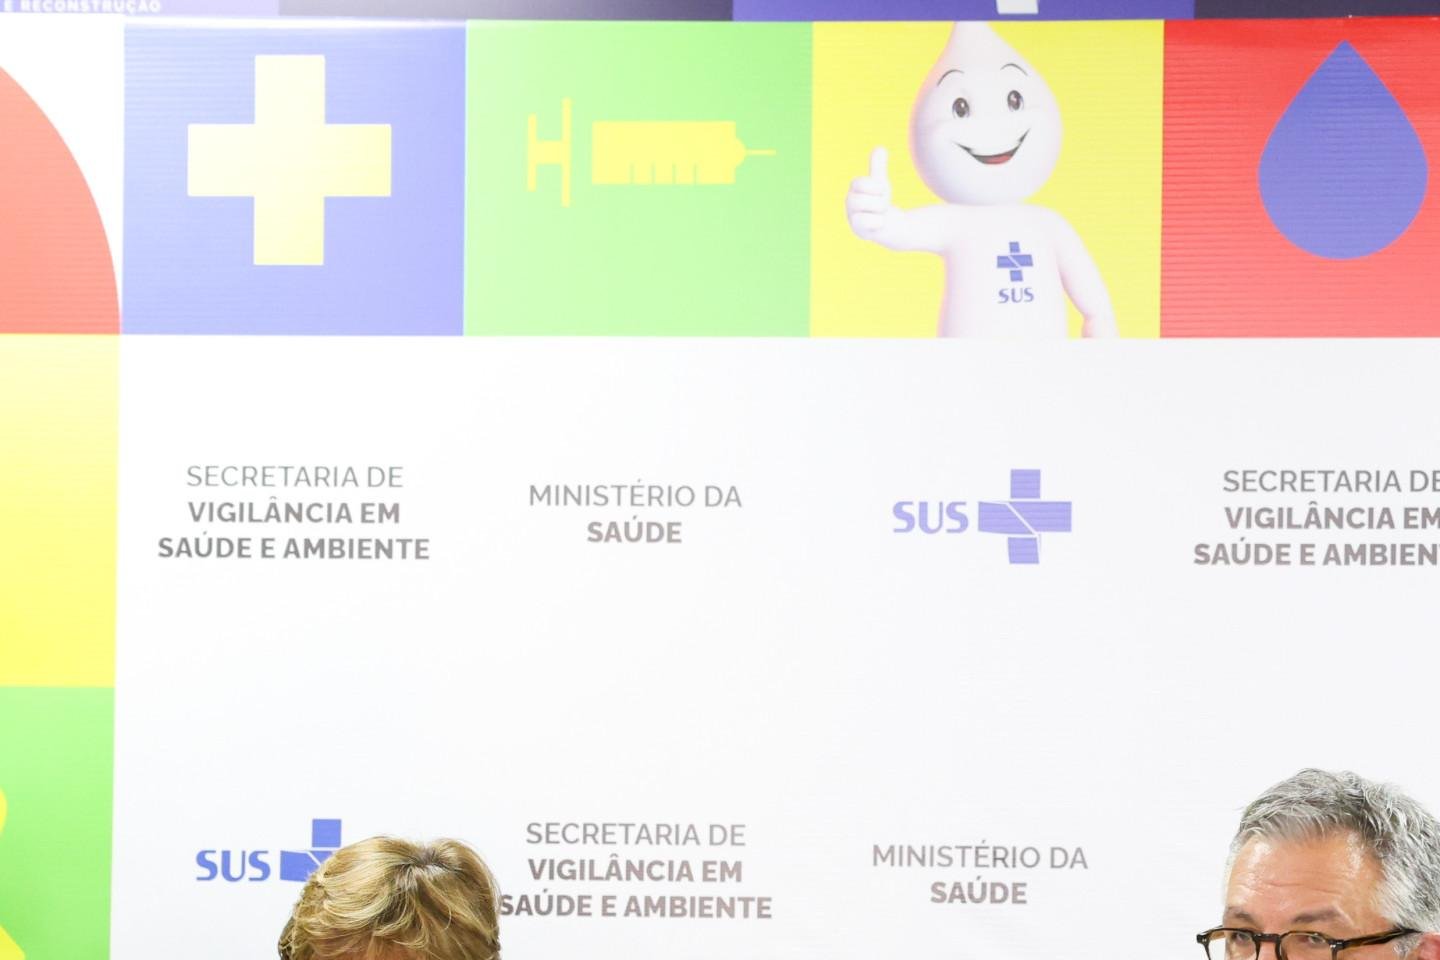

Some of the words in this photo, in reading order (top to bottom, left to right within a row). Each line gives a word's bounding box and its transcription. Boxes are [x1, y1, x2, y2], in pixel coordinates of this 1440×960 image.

[997, 287, 1035, 304] SUS
[186, 465, 360, 488] SECRETARIA
[367, 465, 403, 488] DE
[1222, 469, 1402, 493] SECRETARIA
[529, 478, 696, 508] MINISTÉRIO
[704, 485, 743, 508] DA
[187, 495, 353, 524] VIGILÂNCIA
[360, 502, 400, 524] EM
[892, 500, 970, 535] SUS
[1223, 500, 1396, 530] VIGILÂNCIA
[586, 514, 683, 544] SAÚDE
[157, 531, 252, 559] SAÚDE
[260, 537, 276, 559] E
[282, 537, 430, 560] AMBIENTE
[1193, 536, 1292, 566] SAÚDE
[1299, 543, 1316, 566] E
[525, 822, 701, 846] SECRETARIA
[708, 823, 746, 847] DE
[195, 849, 272, 883] SUS
[527, 852, 695, 883] VIGILÂNCIA
[701, 860, 743, 883] EM
[872, 839, 1041, 869] MINISTÉRIO
[1049, 846, 1089, 870] DA
[500, 888, 593, 917] SAÚDE
[601, 894, 617, 918] E
[623, 895, 773, 920] AMBIENTE
[930, 875, 1028, 905] SAÚDE
